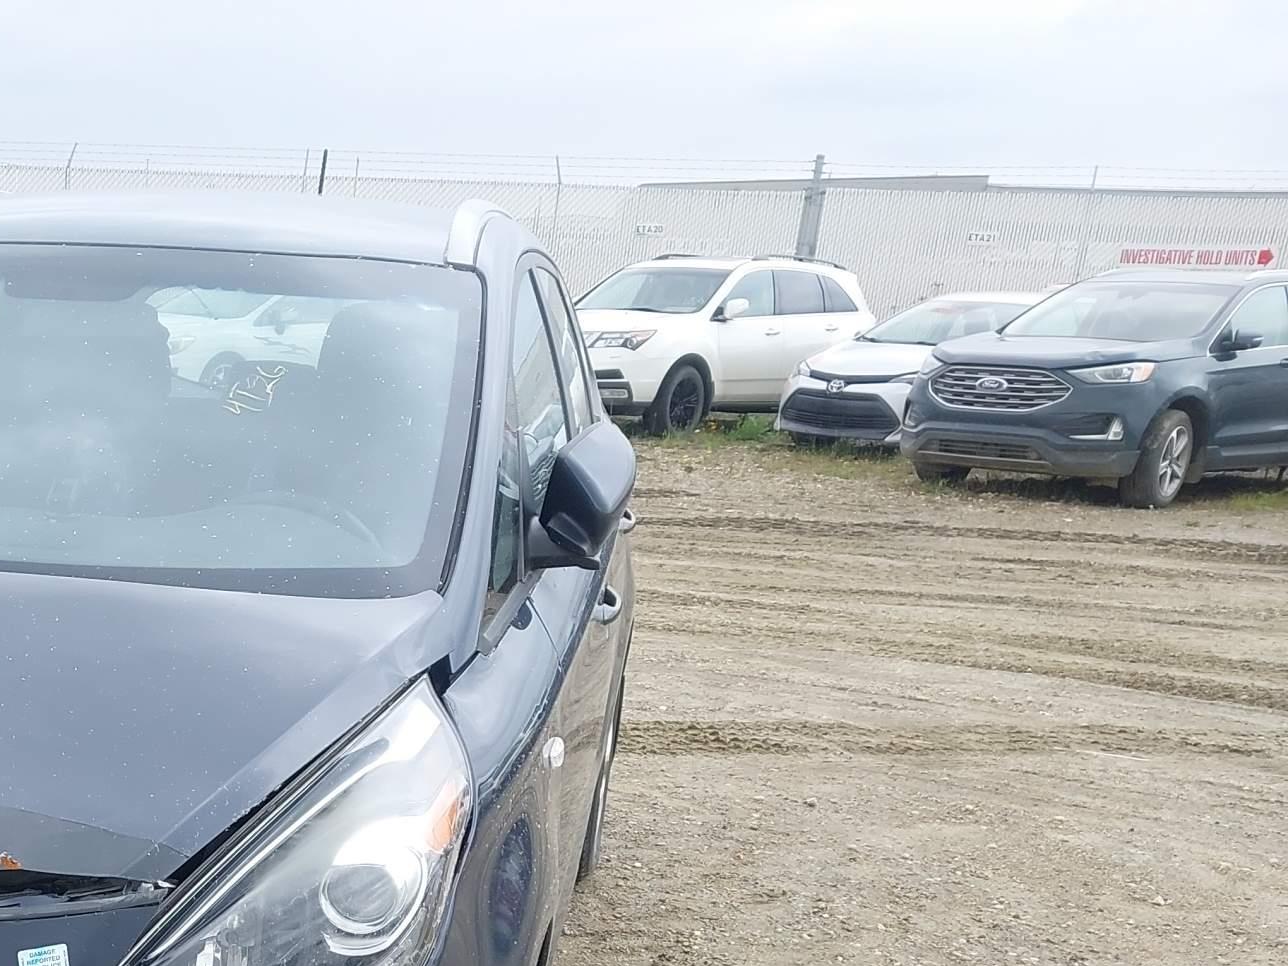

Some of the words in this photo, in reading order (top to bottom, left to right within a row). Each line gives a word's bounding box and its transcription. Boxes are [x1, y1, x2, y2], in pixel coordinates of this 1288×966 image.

[1120, 248, 1194, 264] INVESTIGATIVE
[1195, 250, 1224, 265] HOLD
[1225, 250, 1257, 265] UNITS
[29, 949, 56, 958] DAMAGE
[27, 955, 61, 965] REPORTED
